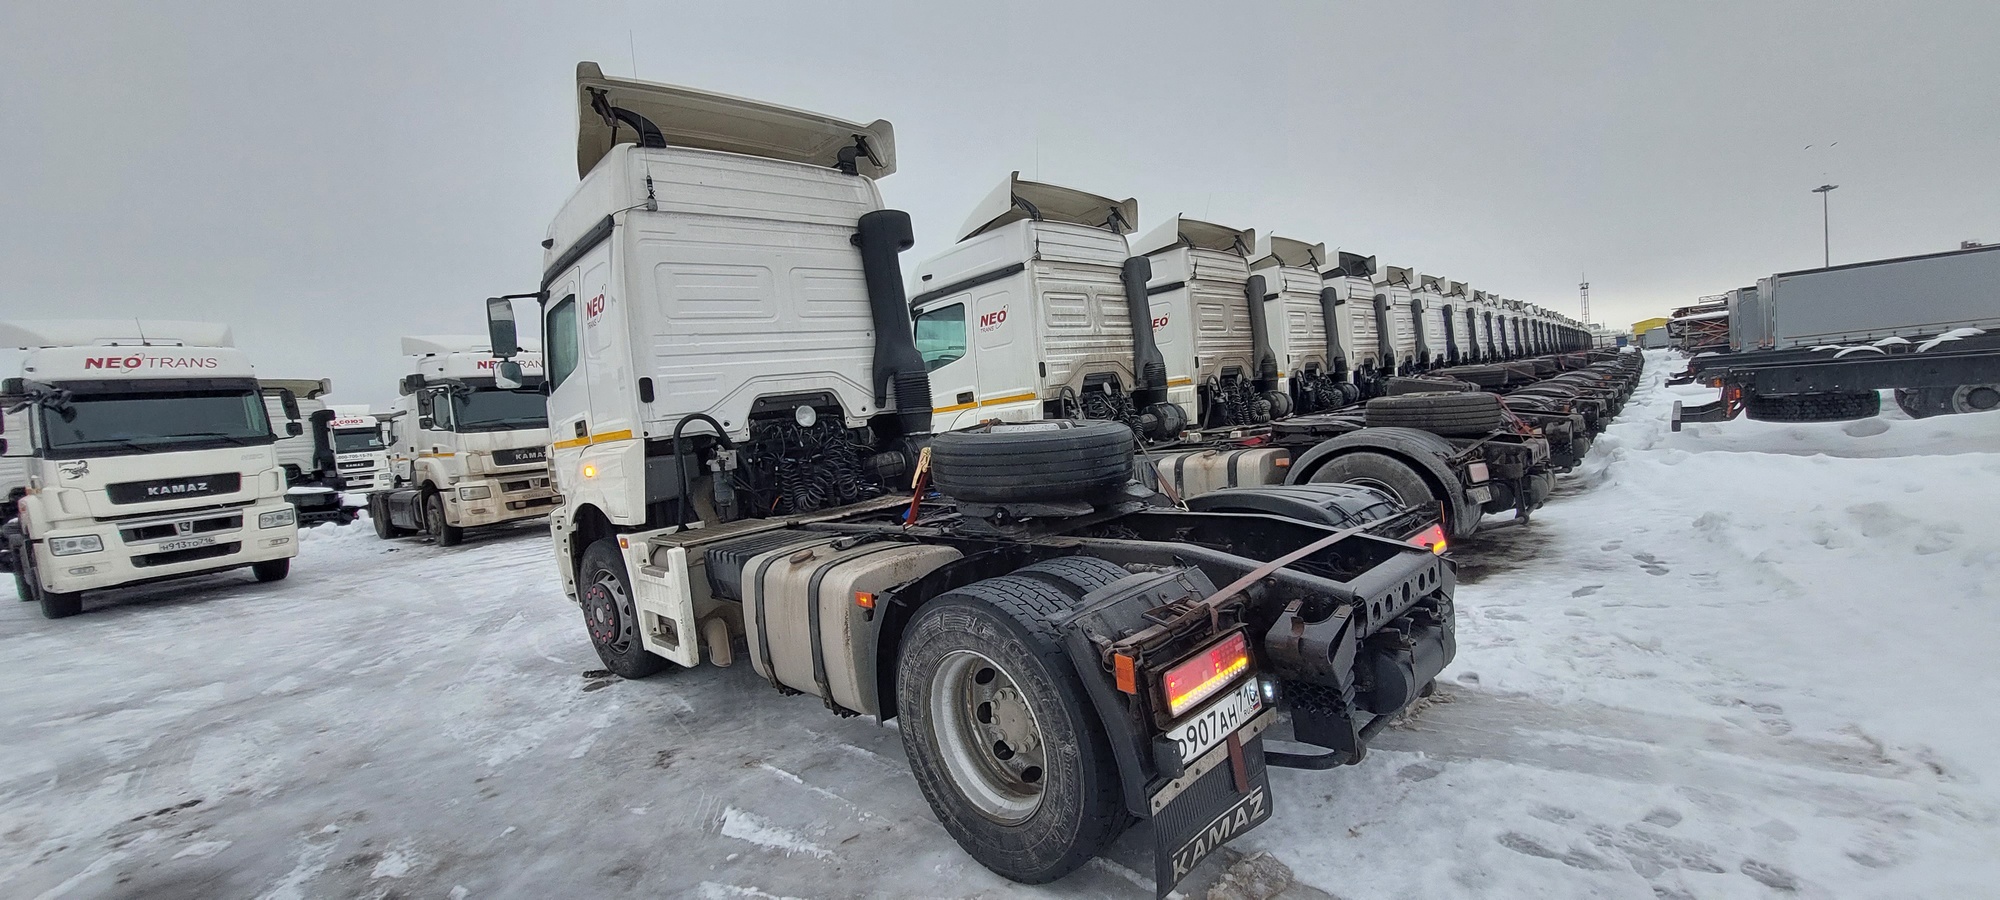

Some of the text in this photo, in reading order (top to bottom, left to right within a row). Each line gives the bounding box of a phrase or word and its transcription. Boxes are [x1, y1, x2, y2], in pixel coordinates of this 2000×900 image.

[586, 293, 605, 321] NEO
[980, 310, 1007, 328] NEO
[1152, 317, 1168, 328] EO
[477, 360, 543, 370] NE RAN
[147, 482, 208, 496] KAMAZ
[1243, 706, 1254, 716] RUS
[1172, 791, 1265, 883] KAMAZ
